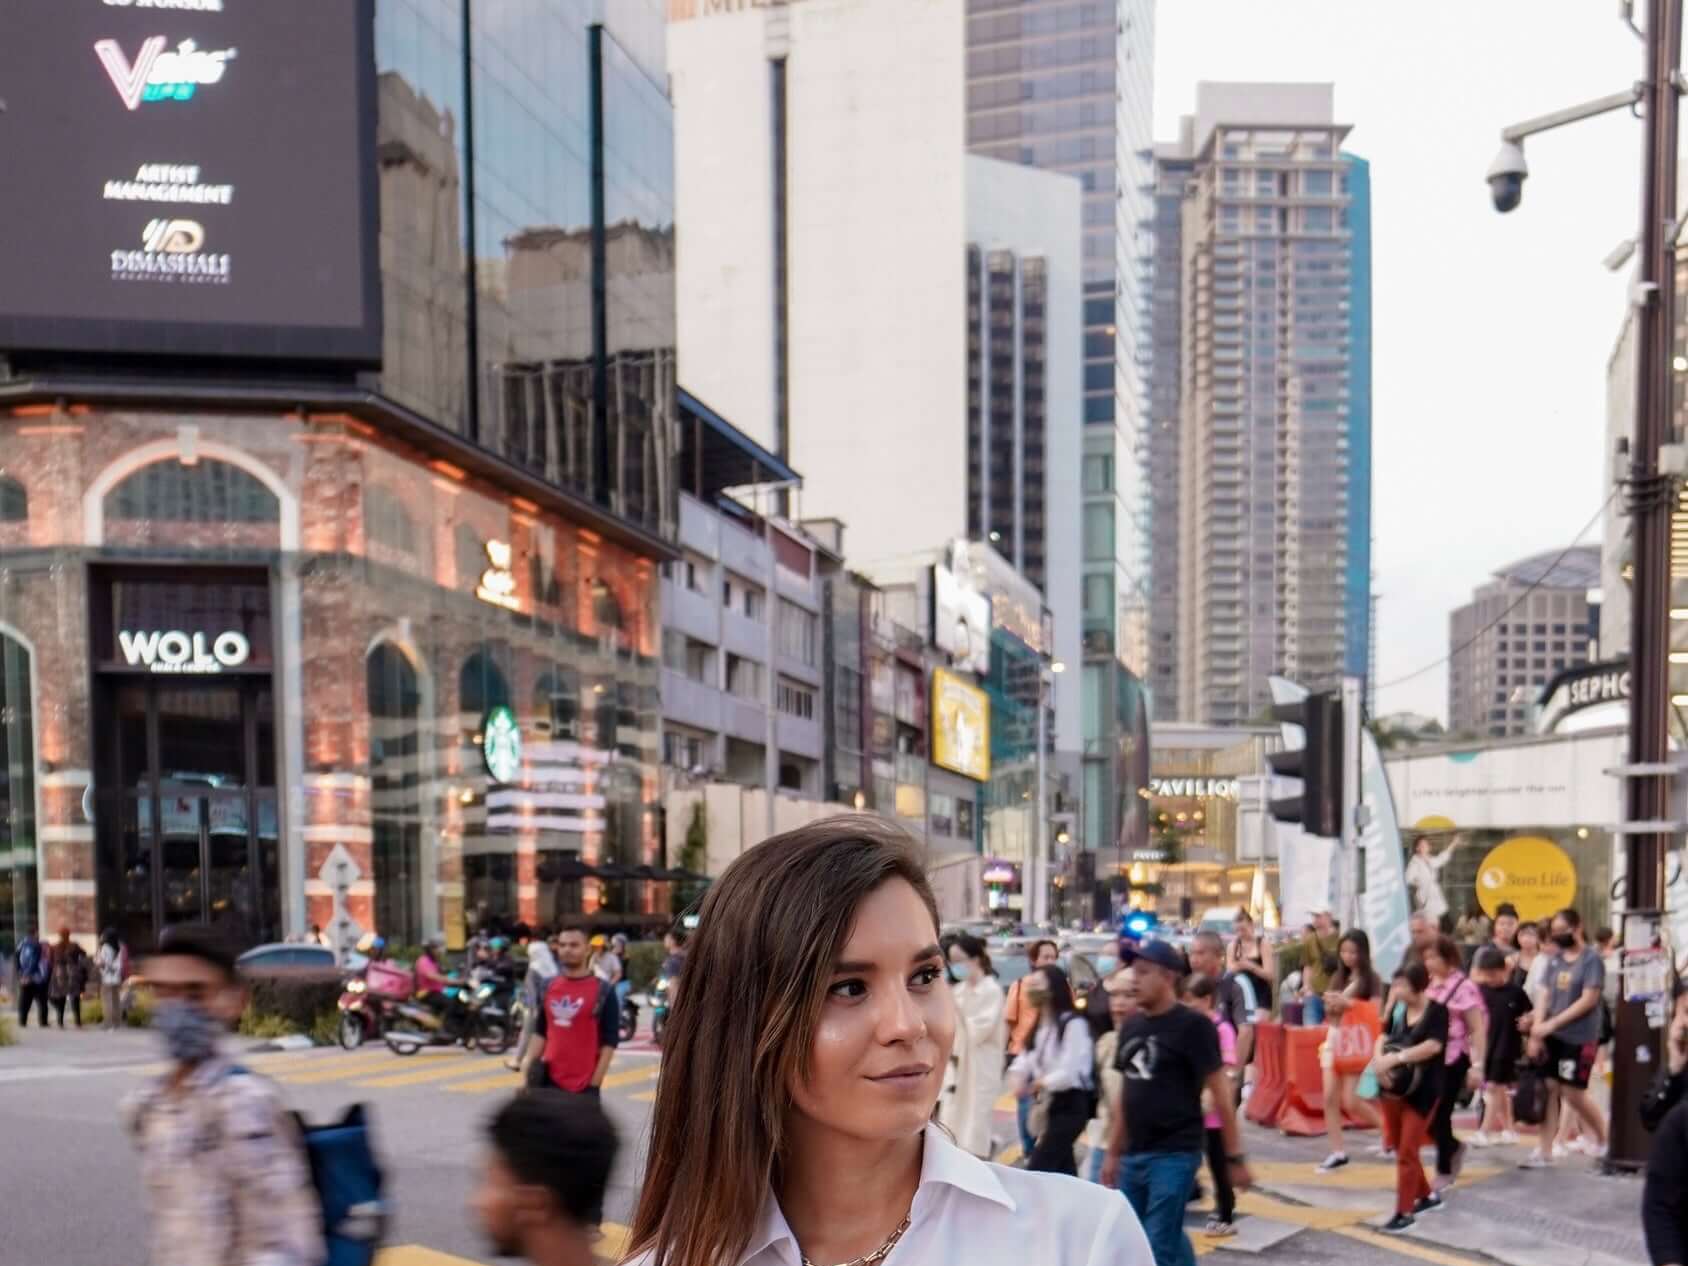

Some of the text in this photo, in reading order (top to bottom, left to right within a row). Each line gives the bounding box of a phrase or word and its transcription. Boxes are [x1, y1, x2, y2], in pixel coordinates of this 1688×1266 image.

[136, 163, 199, 184] ARTIST
[103, 180, 234, 204] MANAGEMENT
[119, 630, 250, 666] WOLO
